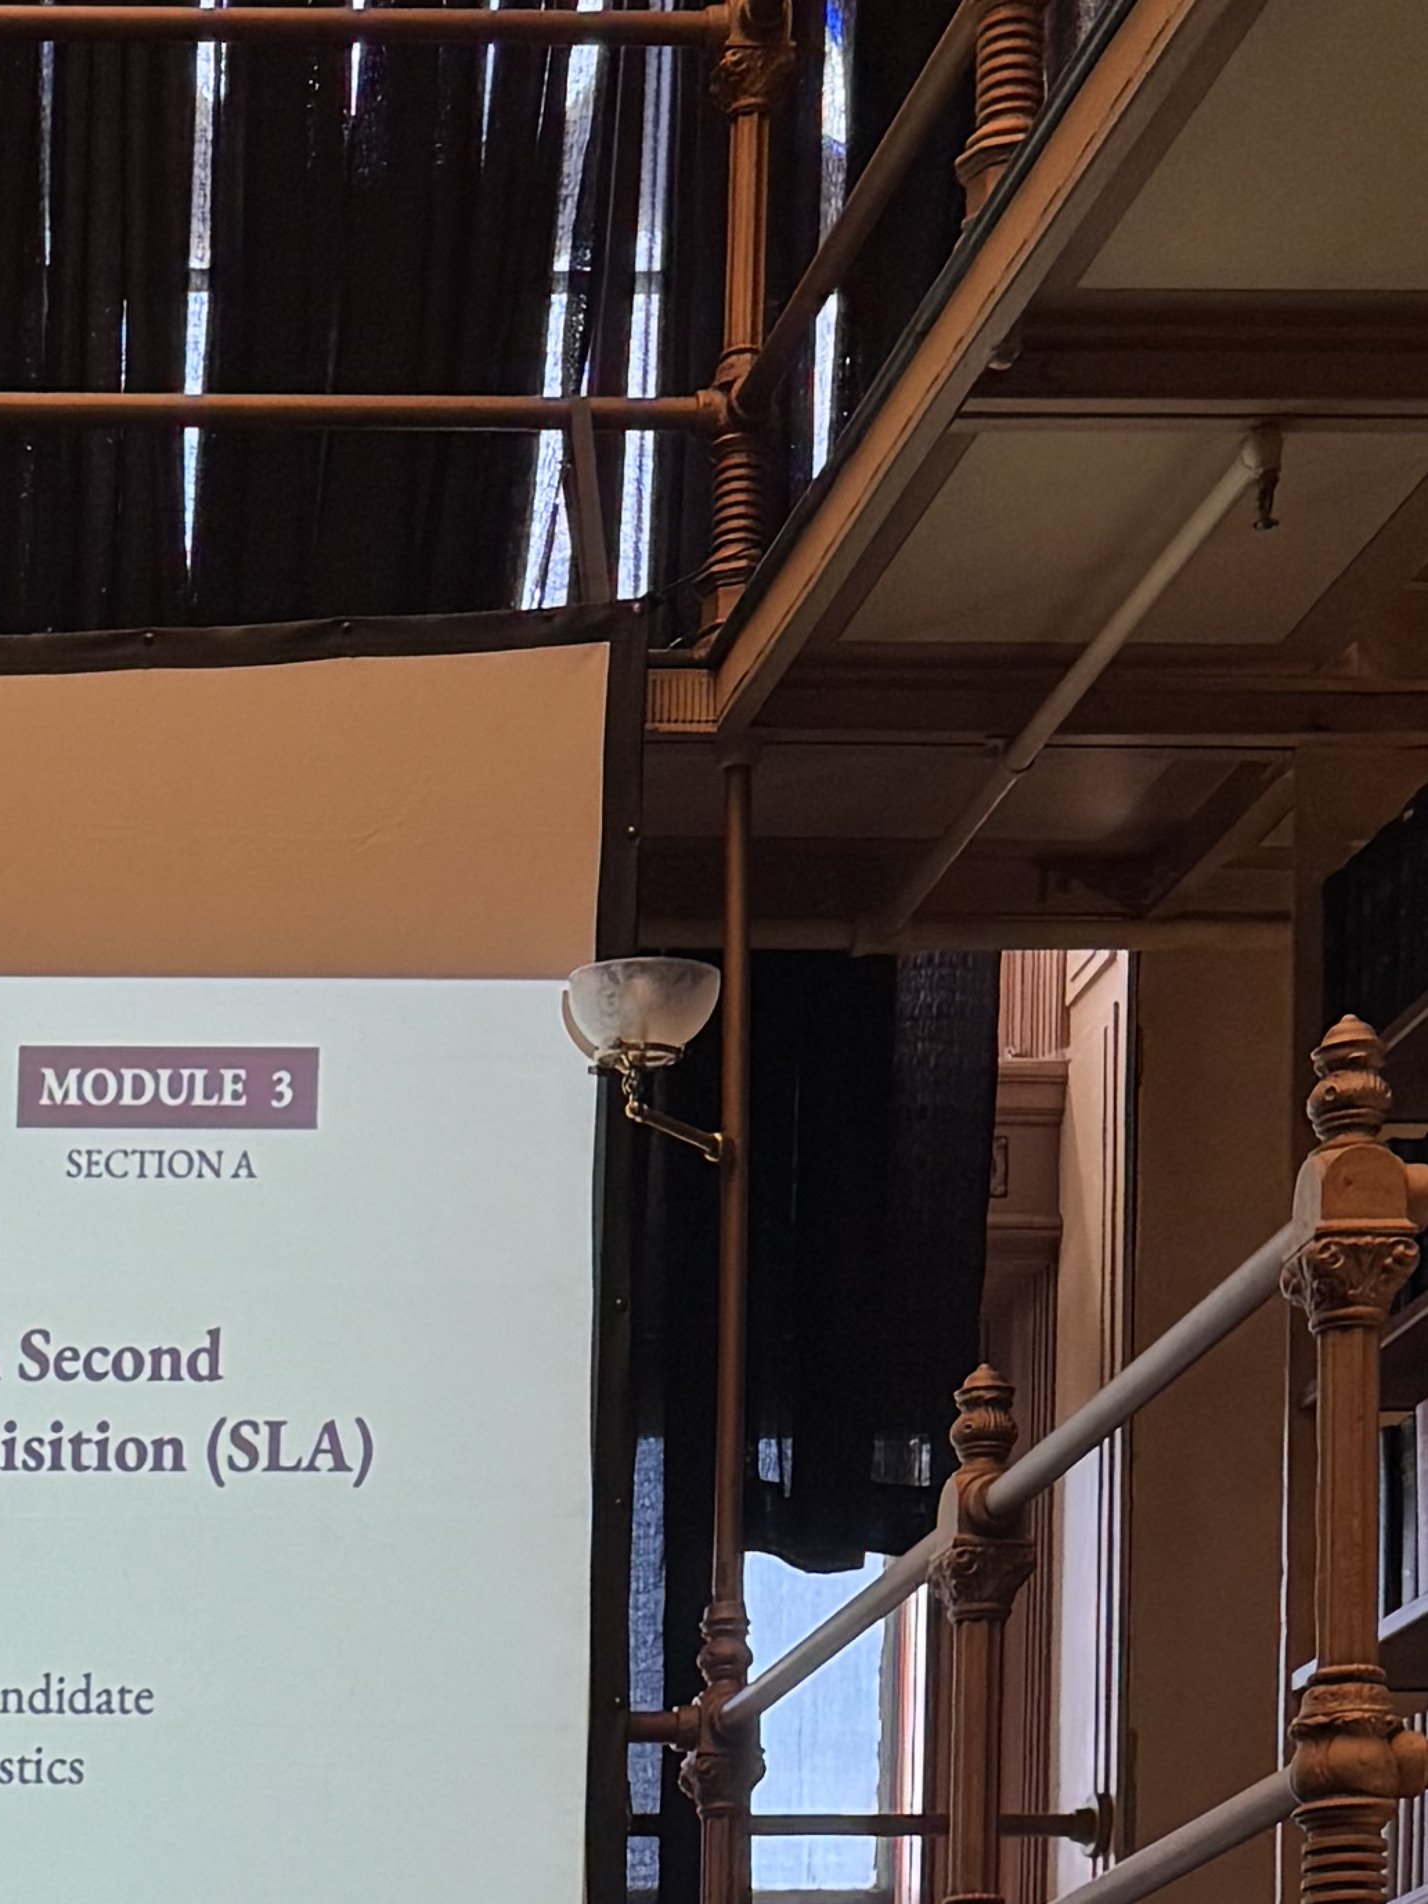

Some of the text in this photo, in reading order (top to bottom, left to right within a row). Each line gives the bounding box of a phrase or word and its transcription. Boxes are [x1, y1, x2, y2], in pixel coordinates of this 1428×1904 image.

[39, 1068, 293, 1108] MODULE 3
[65, 1149, 257, 1179] SECTION A
[18, 1327, 224, 1382] Second
[207, 1417, 373, 1488] (SLA)
